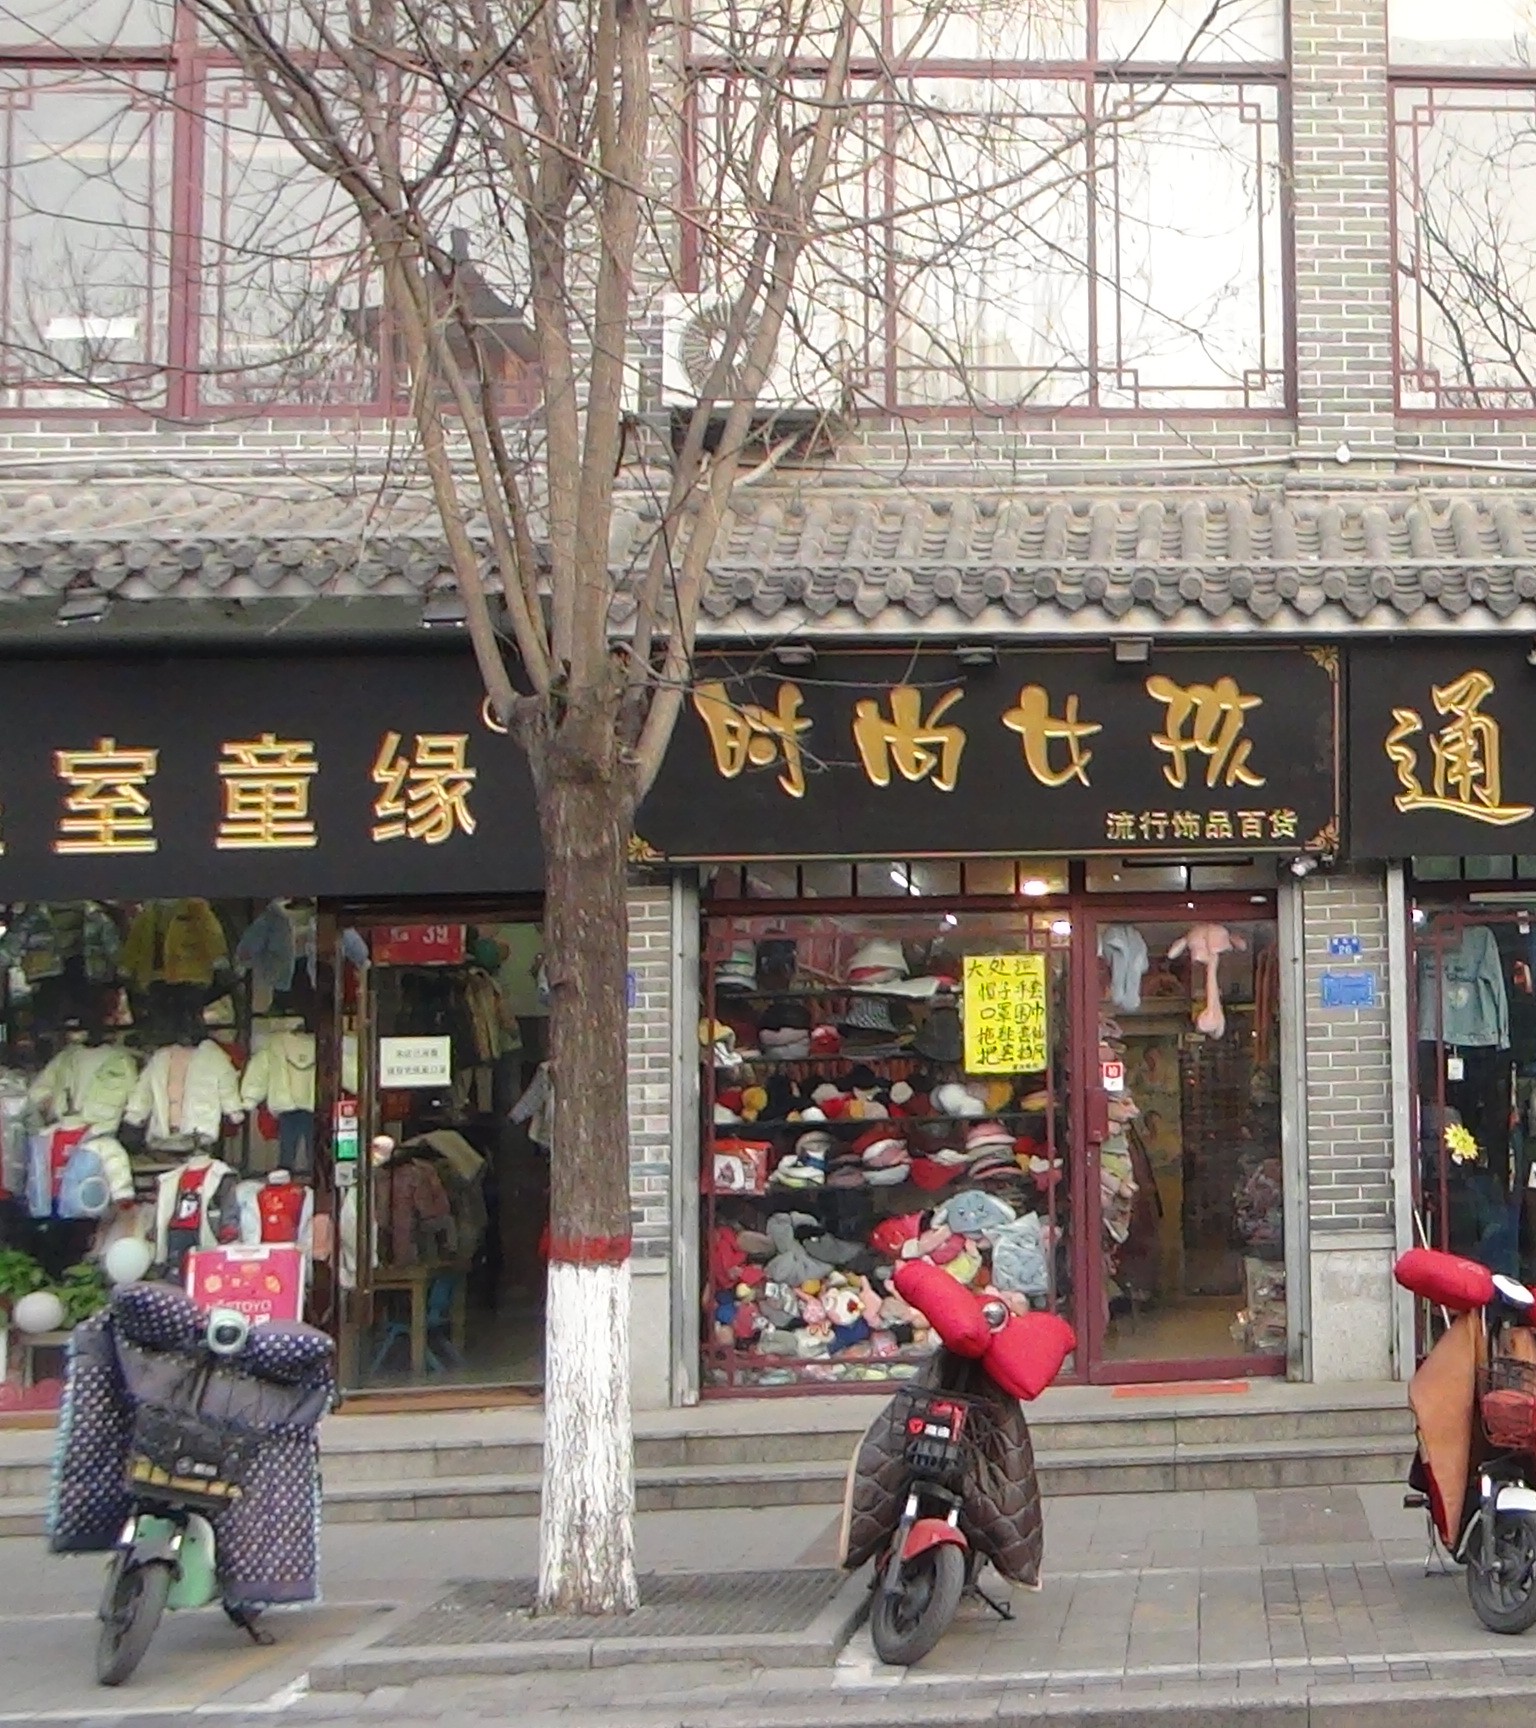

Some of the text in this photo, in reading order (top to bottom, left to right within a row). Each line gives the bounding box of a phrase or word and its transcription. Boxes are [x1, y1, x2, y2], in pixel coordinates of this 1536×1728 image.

[693, 675, 1268, 798] 时尚女孩
[0, 731, 477, 854] 室童缘
[1105, 809, 1299, 841] 流行饰品百货
[979, 1001, 1046, 1025] 口罩围巾
